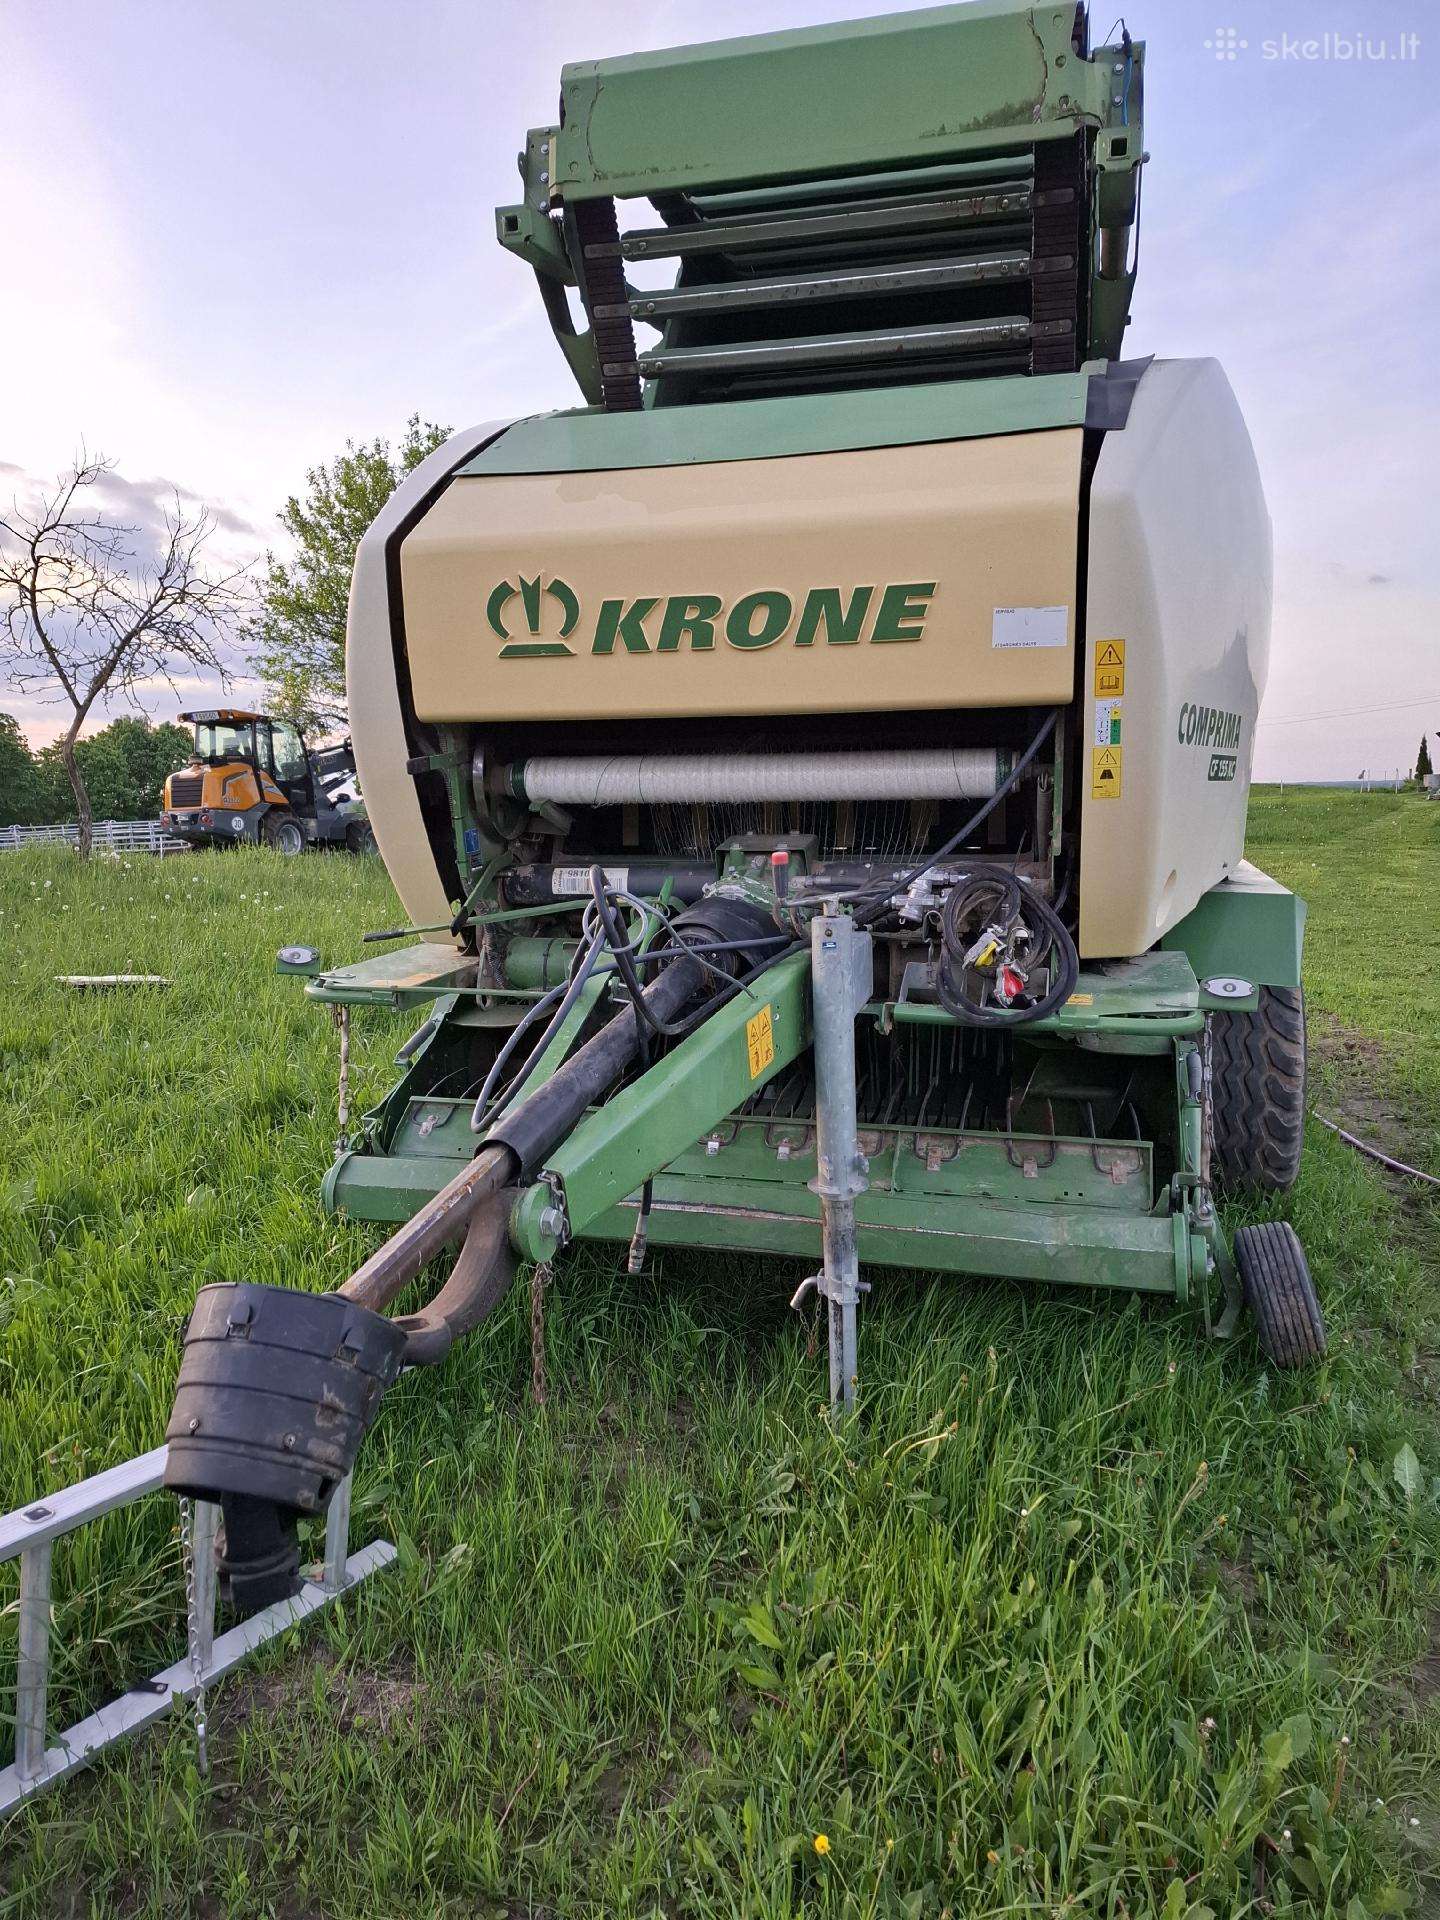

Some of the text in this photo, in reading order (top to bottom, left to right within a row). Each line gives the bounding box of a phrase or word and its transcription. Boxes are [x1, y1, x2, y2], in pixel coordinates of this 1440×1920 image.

[591, 580, 939, 654] KRONE
[1178, 702, 1242, 749] COMPRIMA
[1210, 759, 1219, 777] CF
[234, 819, 242, 829] 30
